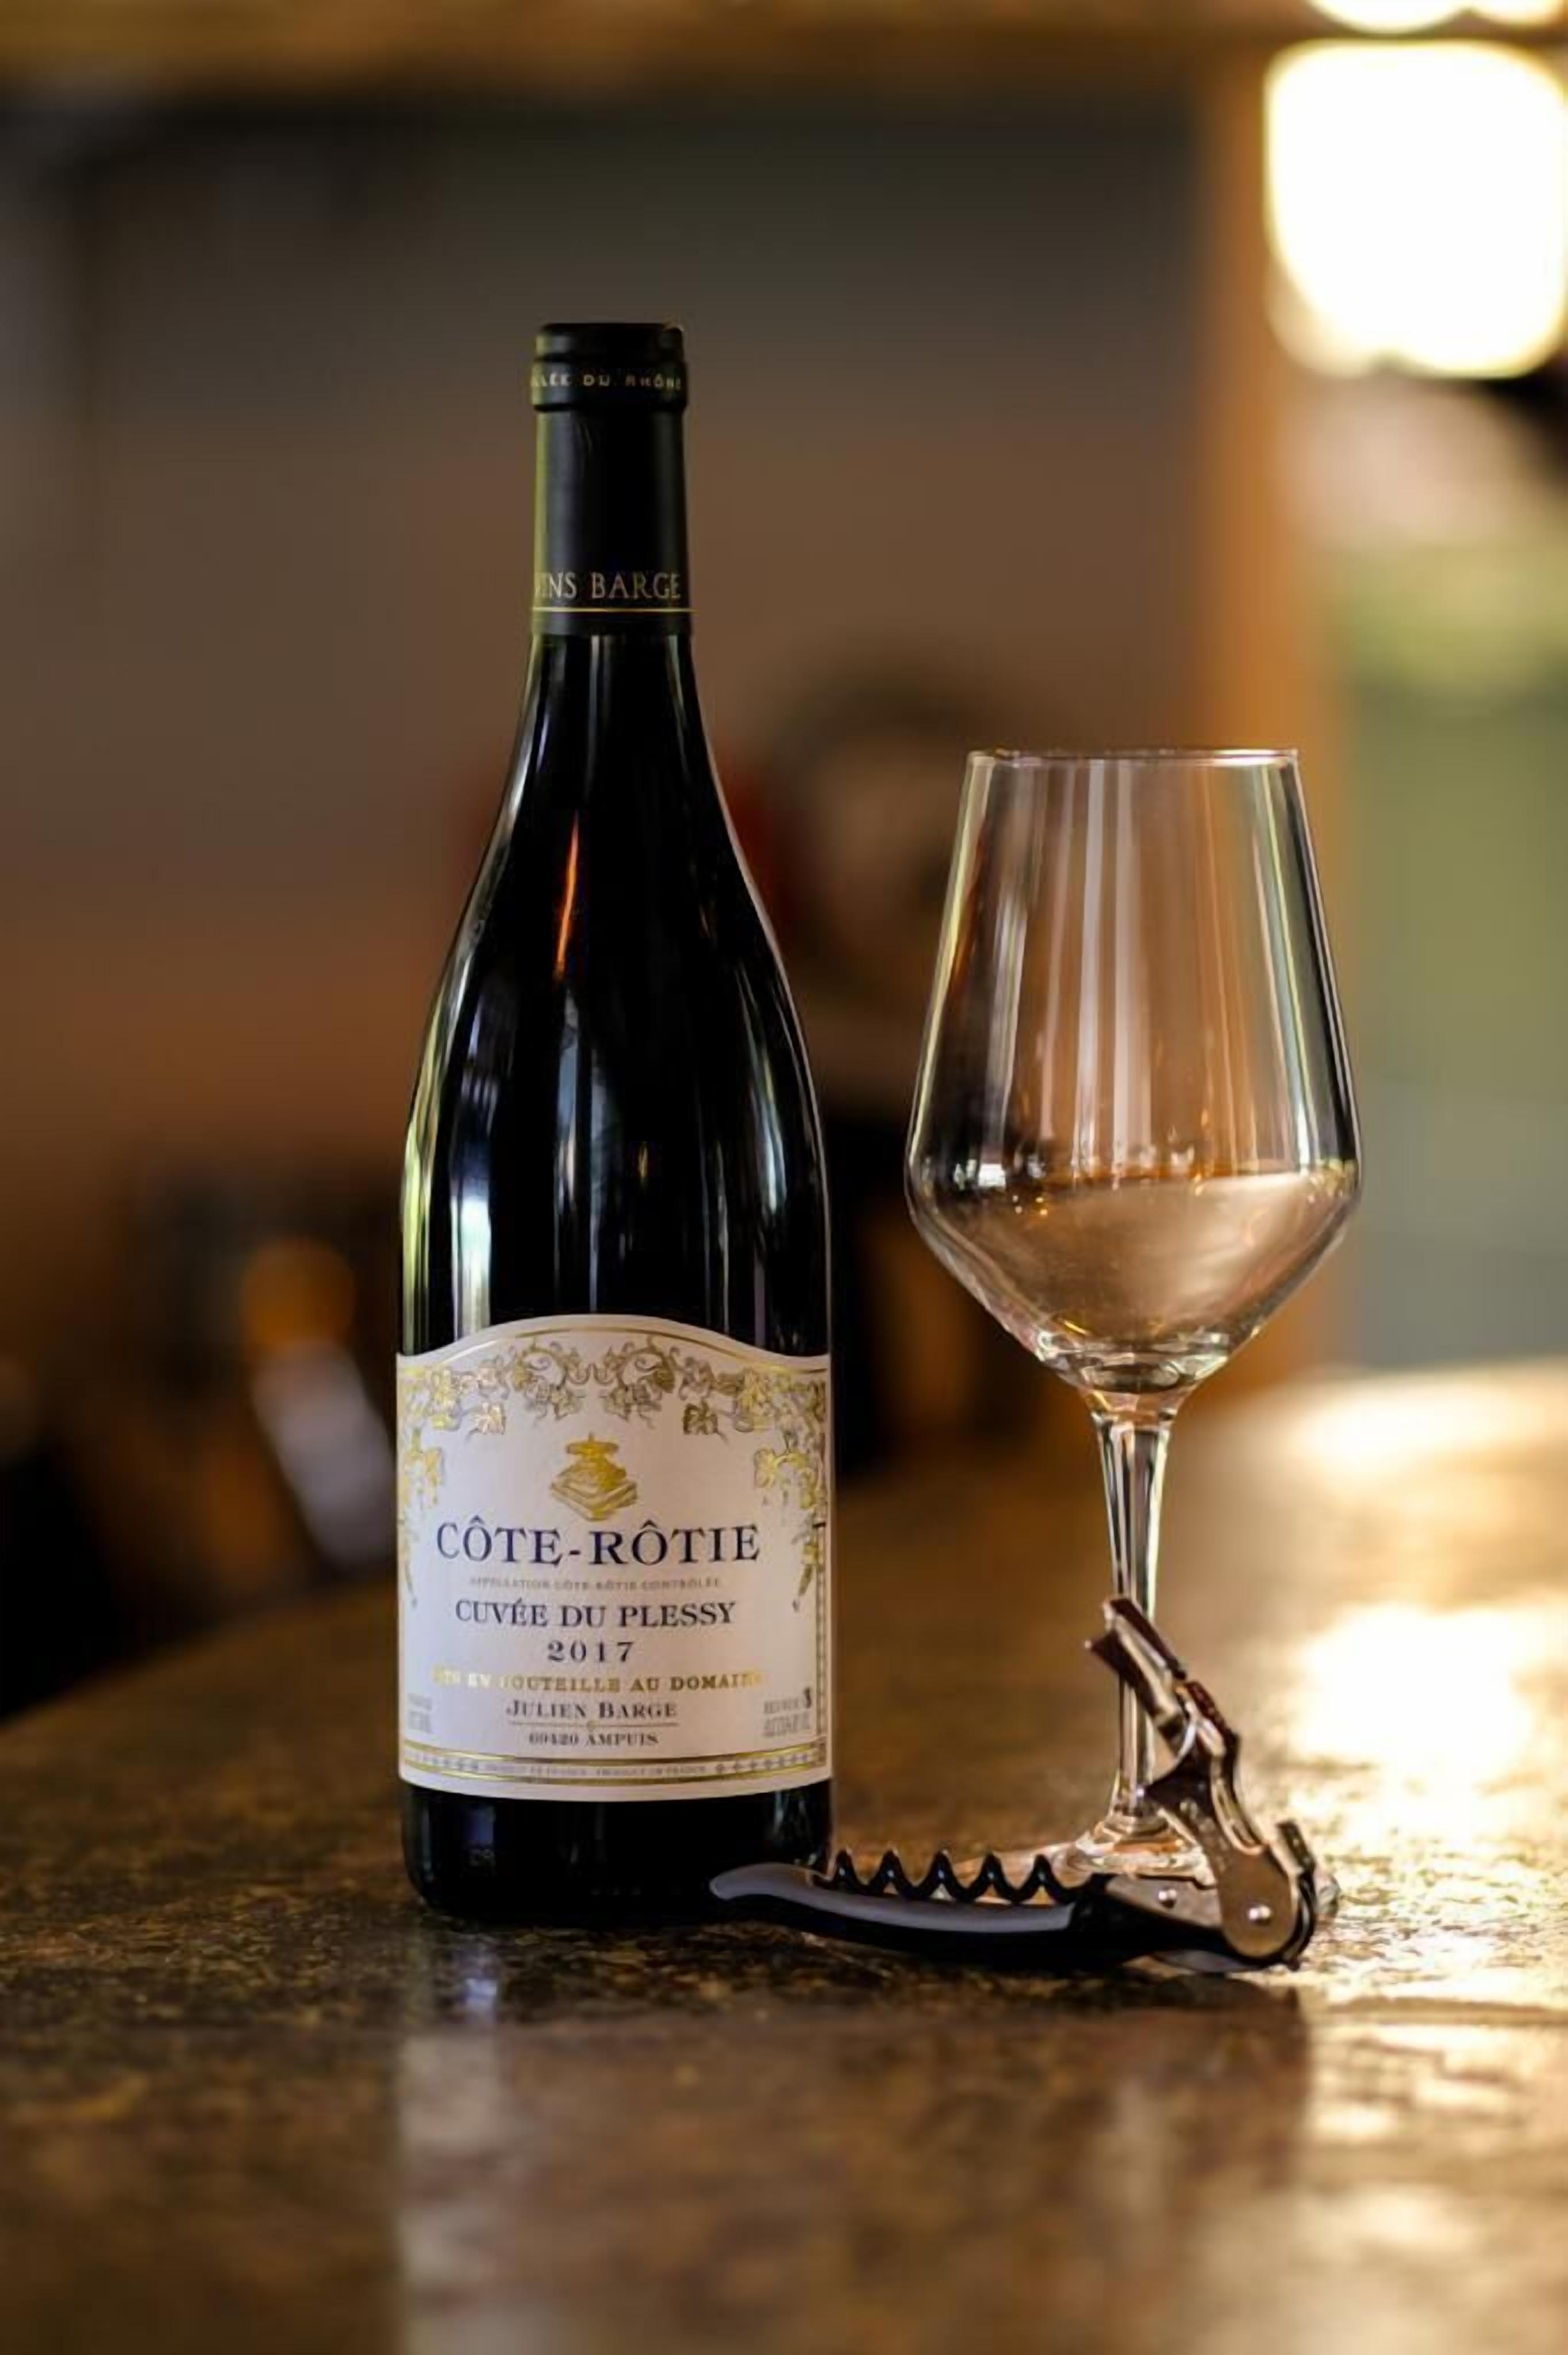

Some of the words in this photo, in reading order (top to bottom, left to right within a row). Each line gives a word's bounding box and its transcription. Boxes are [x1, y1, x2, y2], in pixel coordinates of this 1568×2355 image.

[583, 375, 610, 386] DU
[591, 572, 681, 599] BARGE
[437, 1515, 760, 1567] CÔTE-RÔTIE
[455, 1597, 548, 1627] CUVÉE
[559, 1604, 606, 1628] DU
[618, 1601, 736, 1628] PLESSY
[547, 1639, 634, 1663] 2017
[630, 1677, 659, 1691] AU
[506, 1699, 587, 1718] JULIEN
[599, 1702, 678, 1719] BARGE
[586, 1731, 659, 1747] AMPUIS
